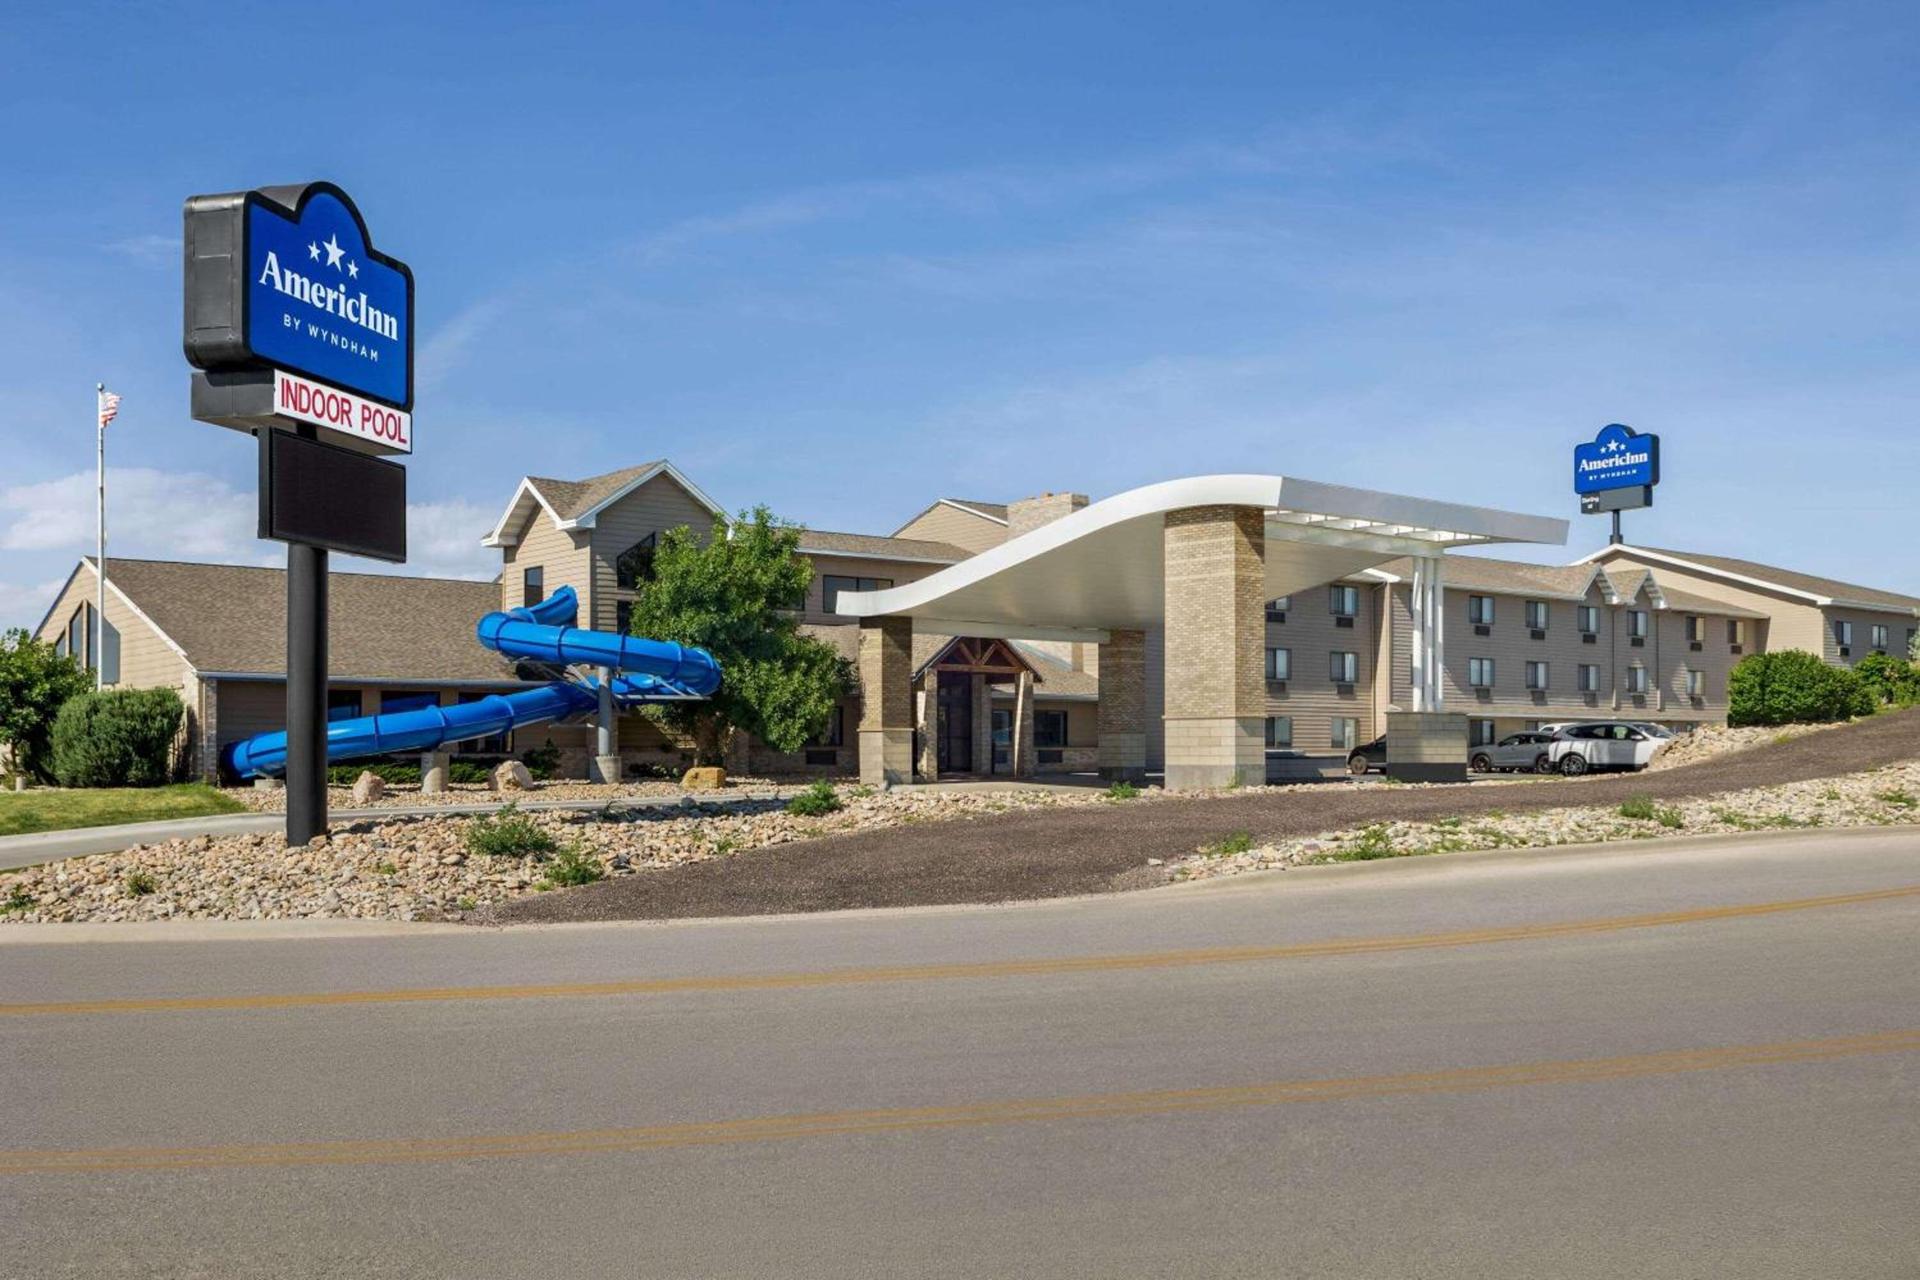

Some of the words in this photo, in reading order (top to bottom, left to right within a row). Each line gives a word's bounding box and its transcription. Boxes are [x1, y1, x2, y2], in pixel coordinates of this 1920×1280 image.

[259, 251, 398, 341] AmericInn
[283, 313, 300, 331] BY
[308, 323, 378, 362] WYNDHAM
[281, 378, 352, 427] INDOOR
[361, 406, 407, 444] POOL
[1579, 452, 1648, 472] AmericInn
